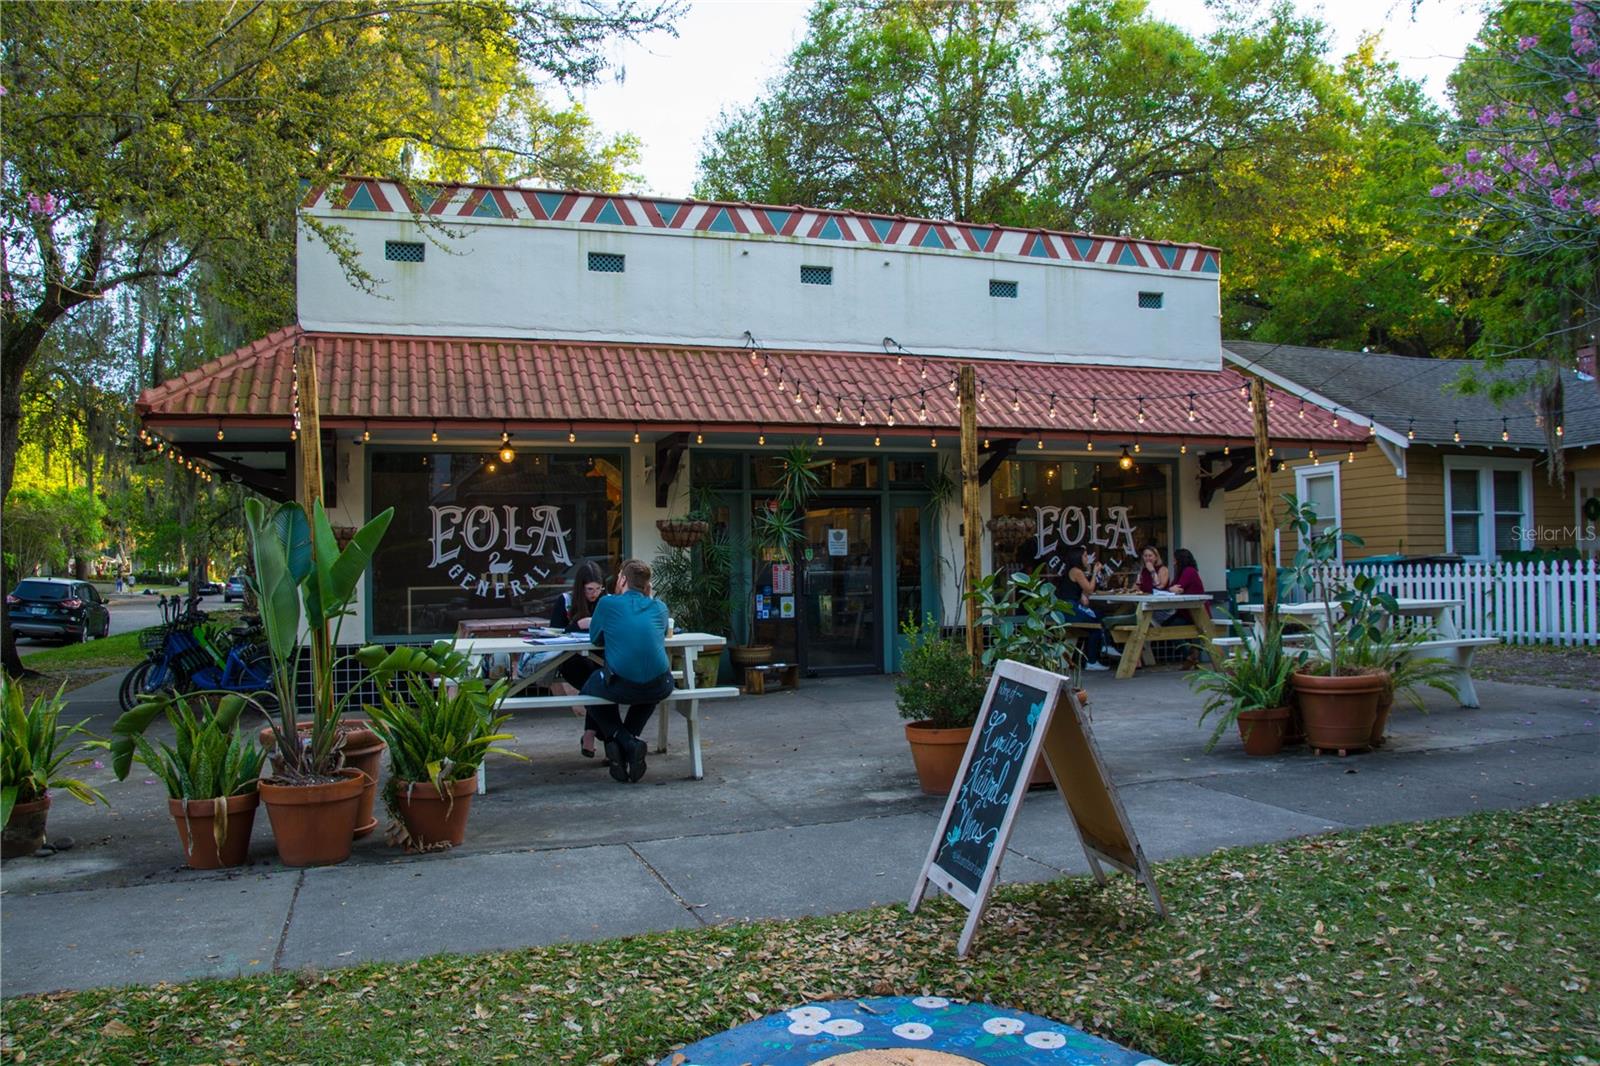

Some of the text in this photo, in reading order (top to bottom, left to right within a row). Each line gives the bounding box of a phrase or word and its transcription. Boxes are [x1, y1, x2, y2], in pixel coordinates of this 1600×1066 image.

[428, 505, 573, 568] EOLA
[1034, 505, 1139, 559] EOLA
[448, 563, 550, 599] GENERAL
